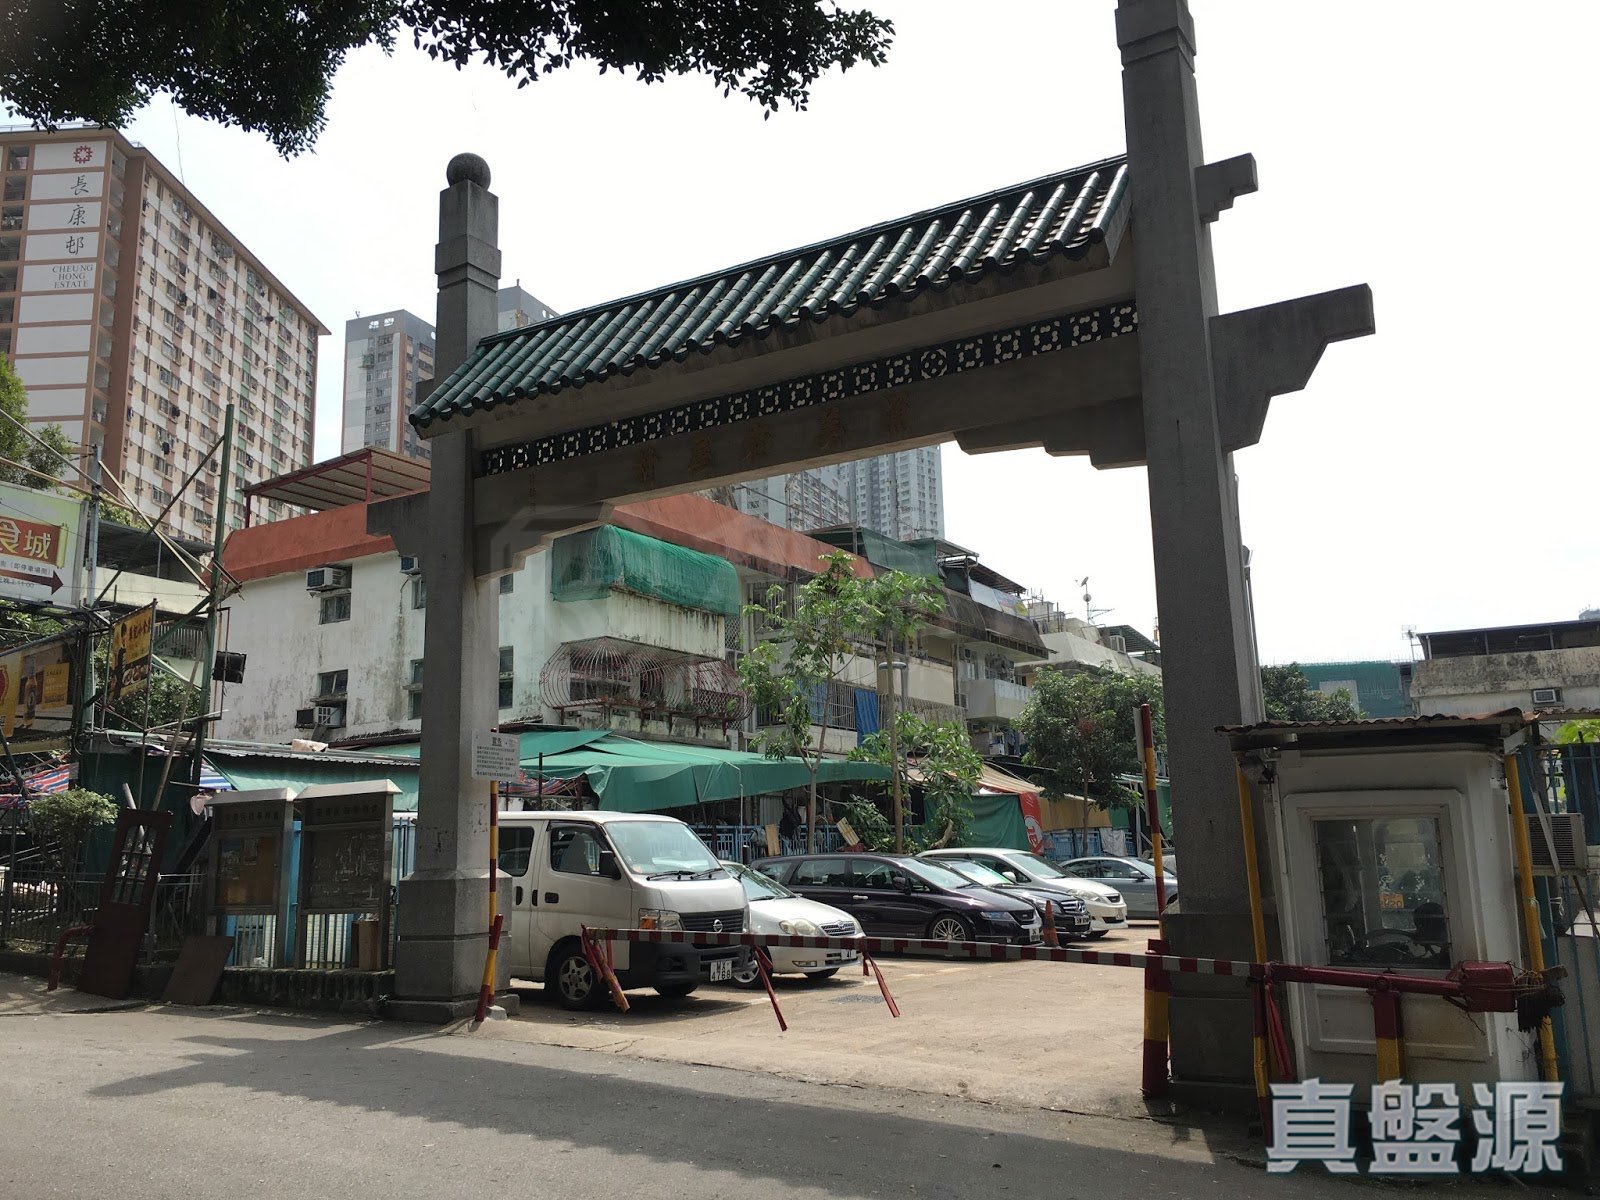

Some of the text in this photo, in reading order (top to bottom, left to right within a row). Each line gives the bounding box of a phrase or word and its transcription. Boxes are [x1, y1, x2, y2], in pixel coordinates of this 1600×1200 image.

[65, 174, 89, 255] 長康邨
[52, 264, 94, 273] CHEUNG
[58, 272, 86, 281] HONG
[54, 280, 88, 289] ESTATE
[712, 969, 731, 981] 4768
